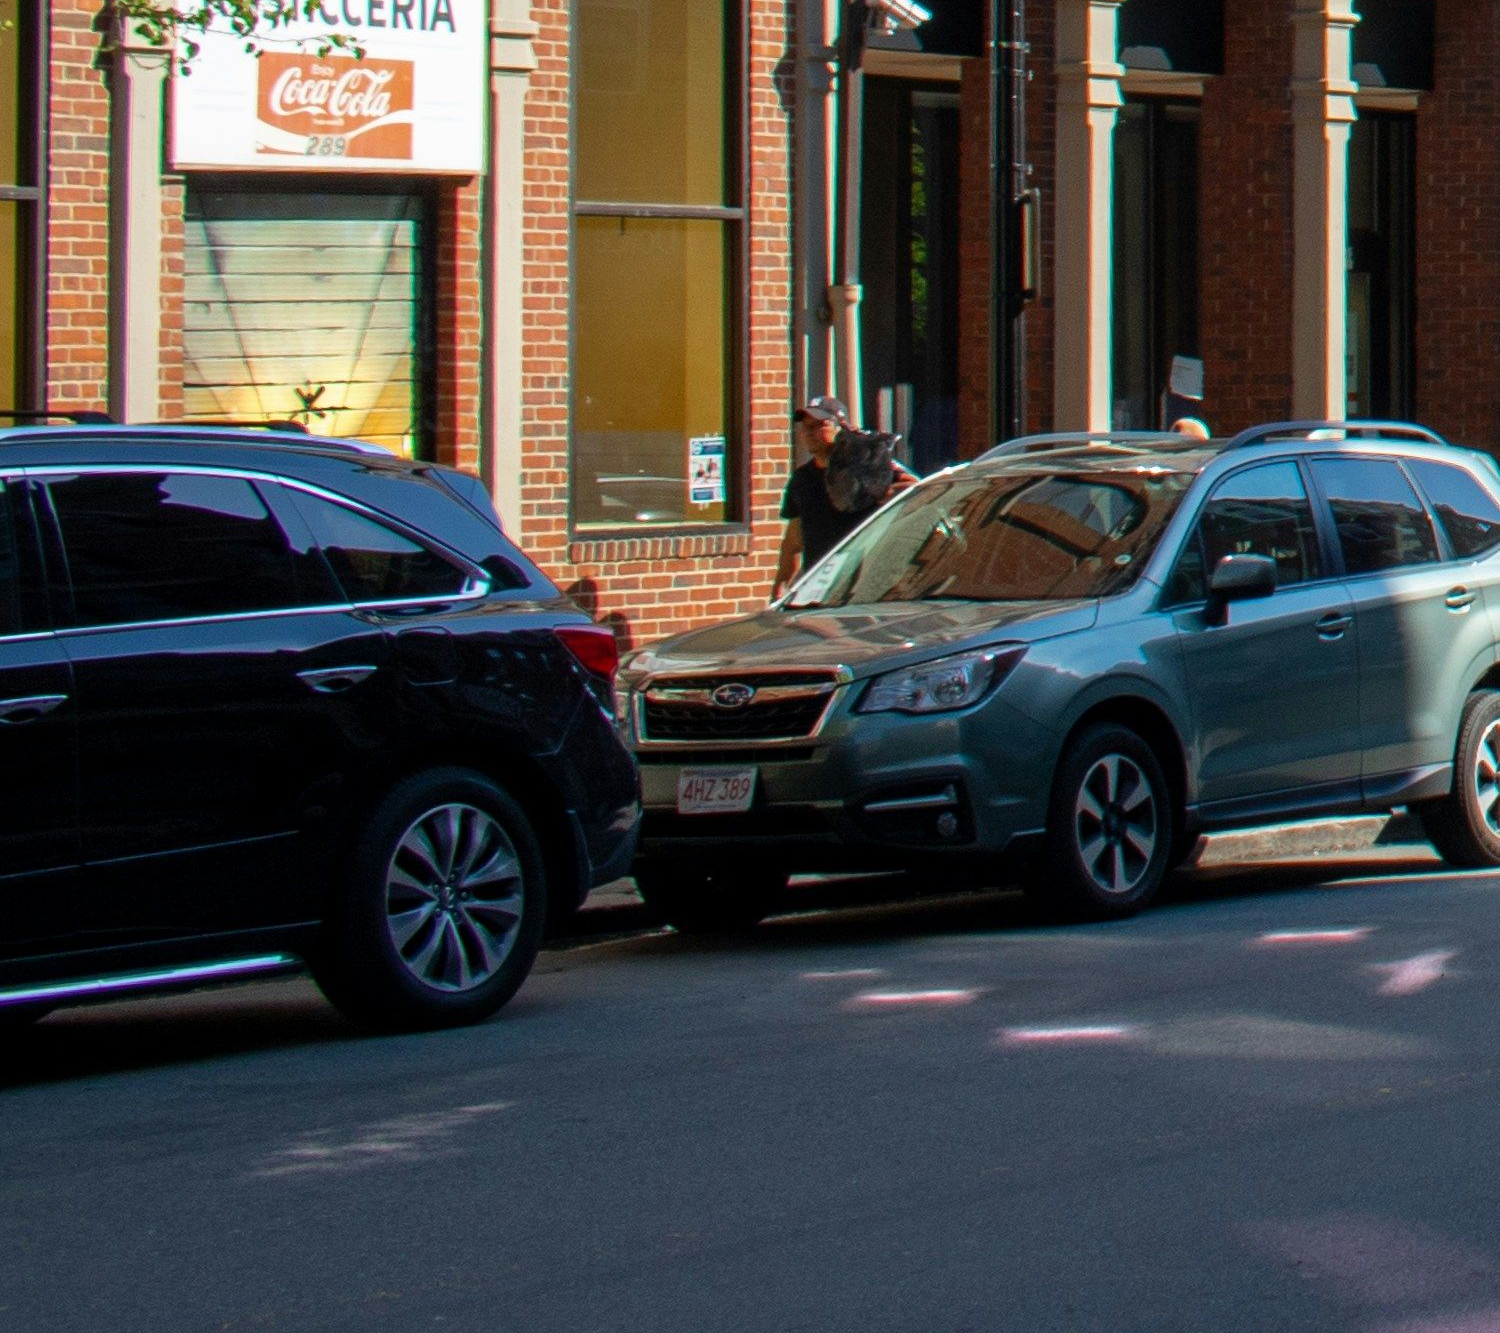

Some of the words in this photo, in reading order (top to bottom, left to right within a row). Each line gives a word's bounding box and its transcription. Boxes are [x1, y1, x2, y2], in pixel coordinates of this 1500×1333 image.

[305, 136, 346, 157] 289
[683, 778, 717, 802] 4HZ
[718, 777, 751, 801] 389
